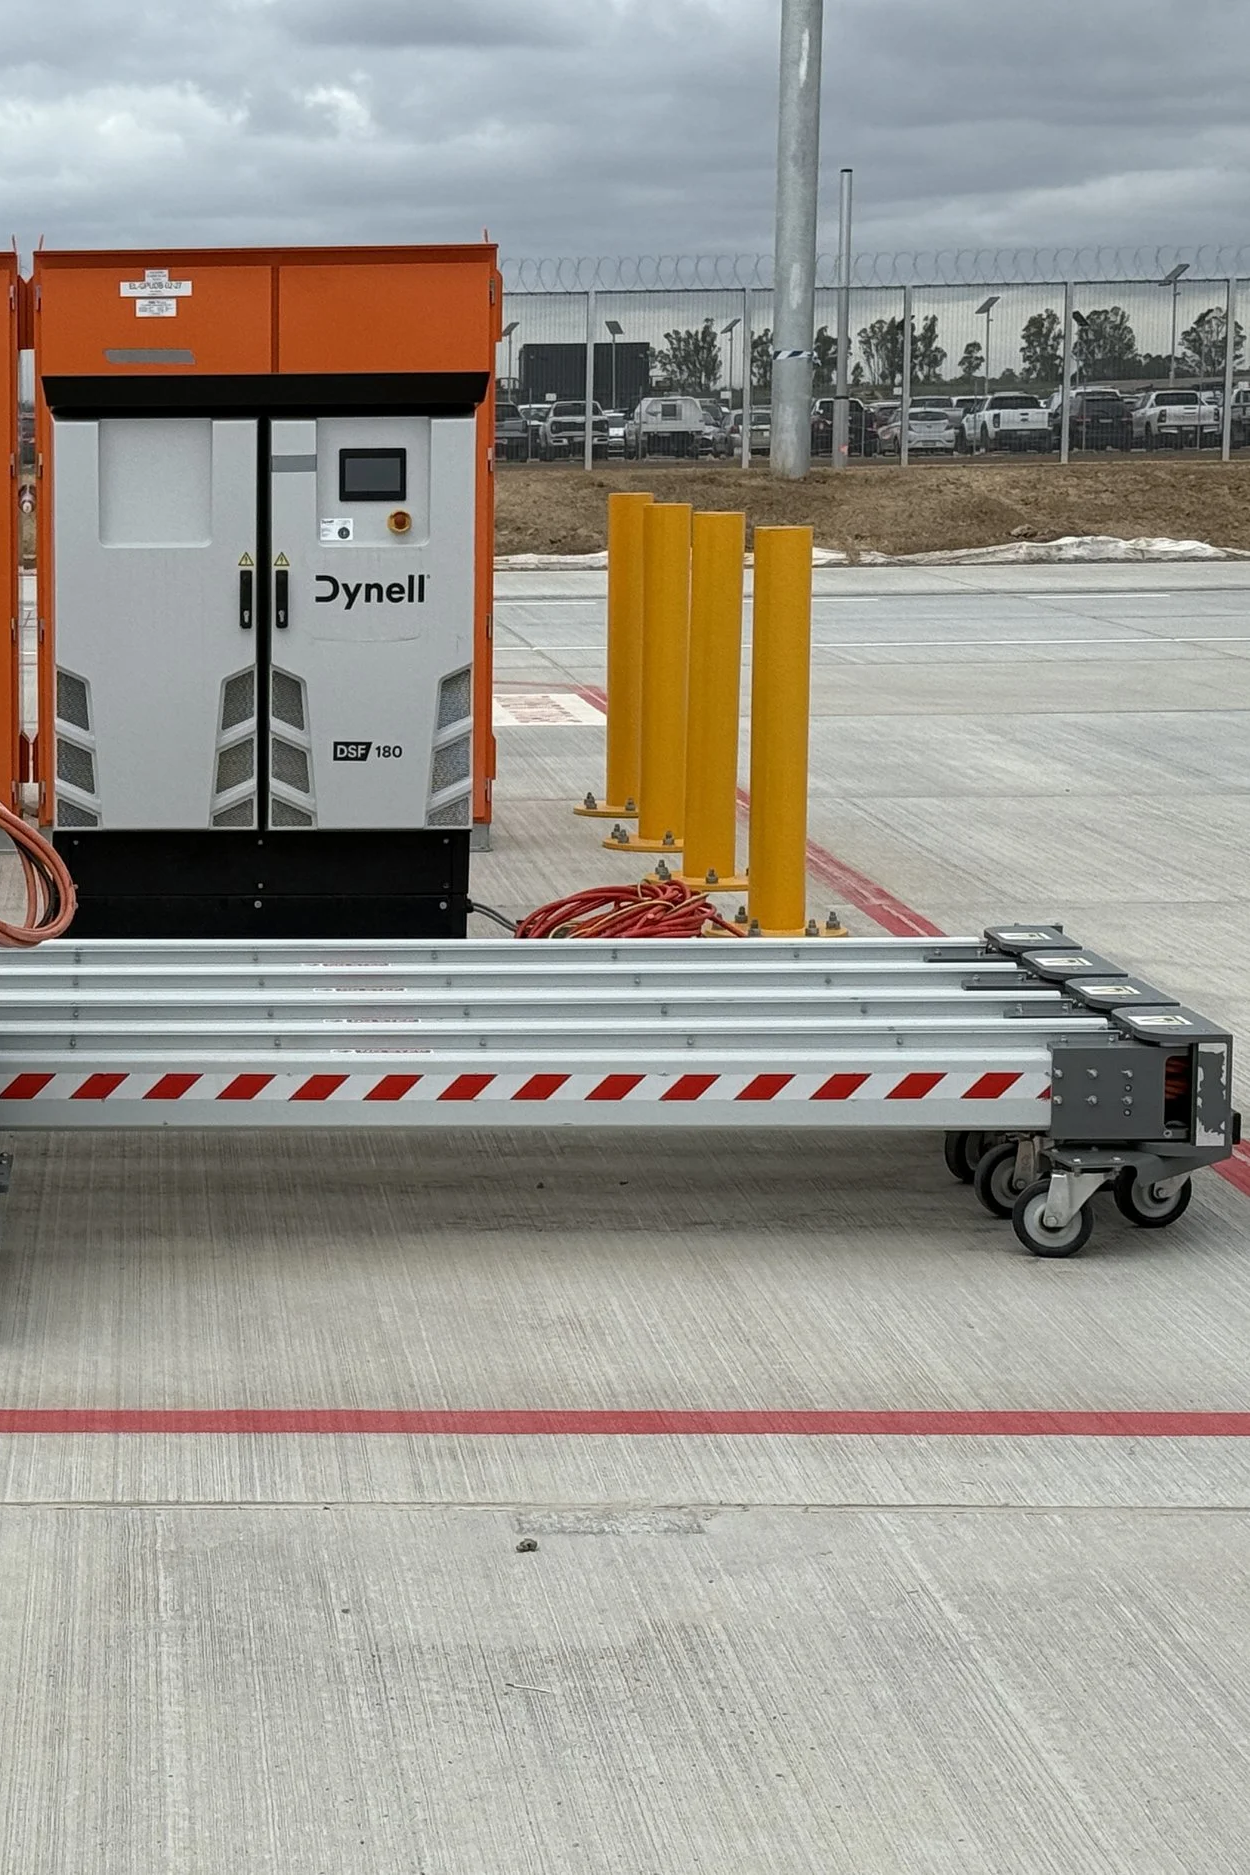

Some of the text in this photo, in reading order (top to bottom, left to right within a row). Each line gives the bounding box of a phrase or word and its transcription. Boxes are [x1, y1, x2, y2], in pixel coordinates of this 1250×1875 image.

[315, 574, 425, 610] Dynell
[336, 745, 403, 758] DSF 180
